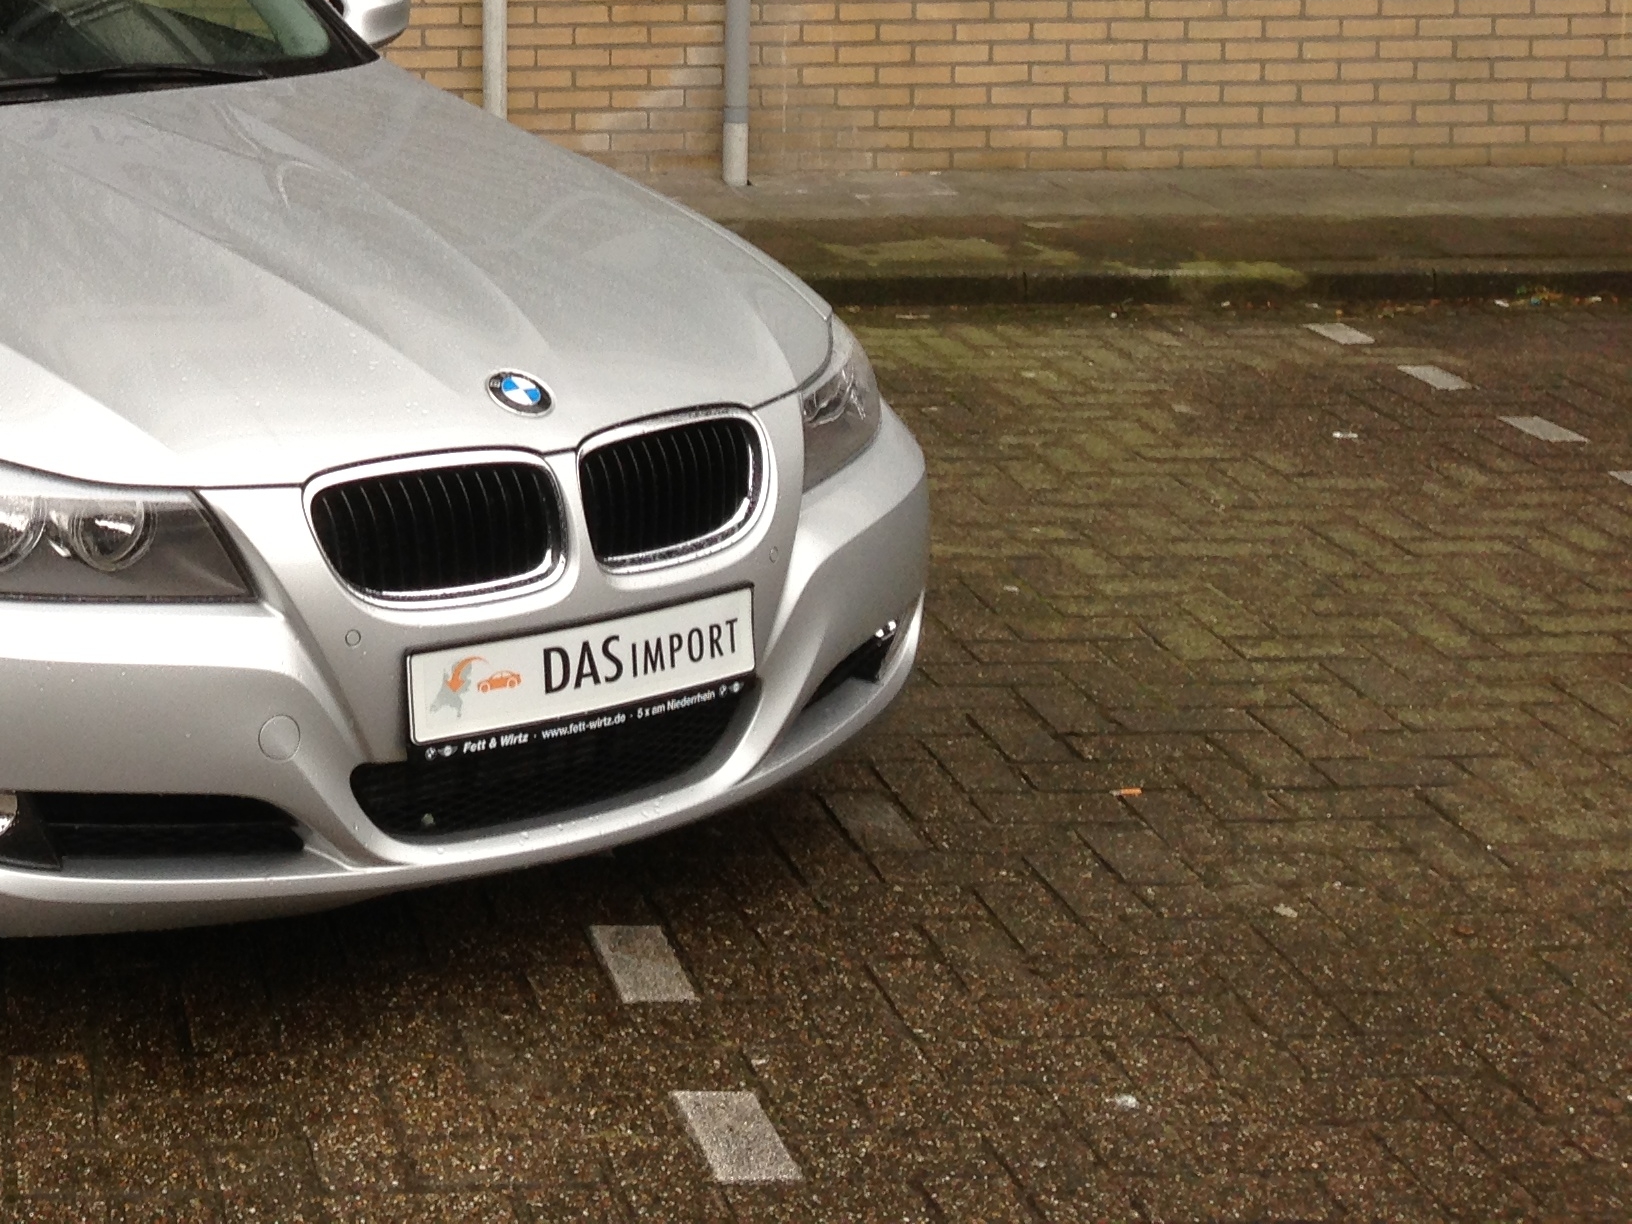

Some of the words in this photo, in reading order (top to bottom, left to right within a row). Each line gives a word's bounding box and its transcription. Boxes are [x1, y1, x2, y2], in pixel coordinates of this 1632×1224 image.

[543, 635, 624, 695] DAS
[631, 617, 739, 678] IMPORT
[500, 732, 529, 748] Wirtz
